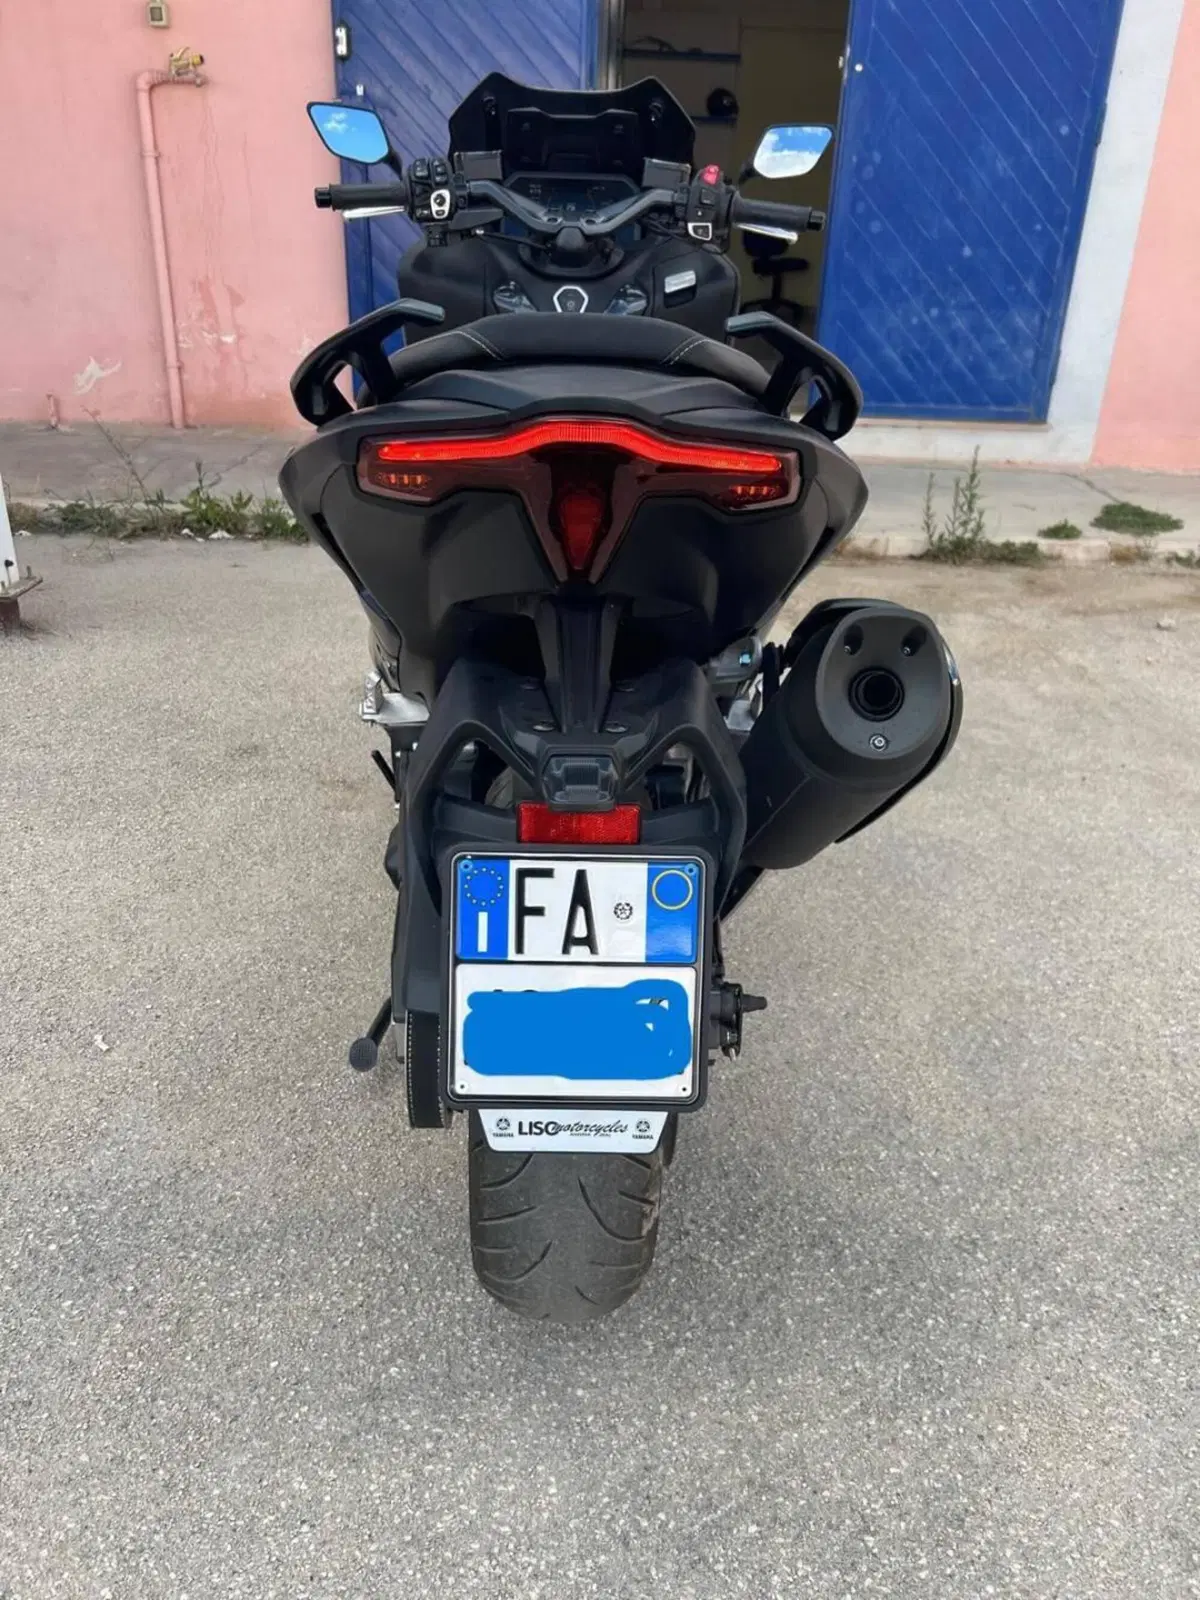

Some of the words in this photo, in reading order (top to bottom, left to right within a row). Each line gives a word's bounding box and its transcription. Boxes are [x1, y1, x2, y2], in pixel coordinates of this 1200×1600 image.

[515, 867, 599, 955] FA
[518, 1120, 560, 1136] LISO
[552, 1119, 628, 1137] motorcycles
